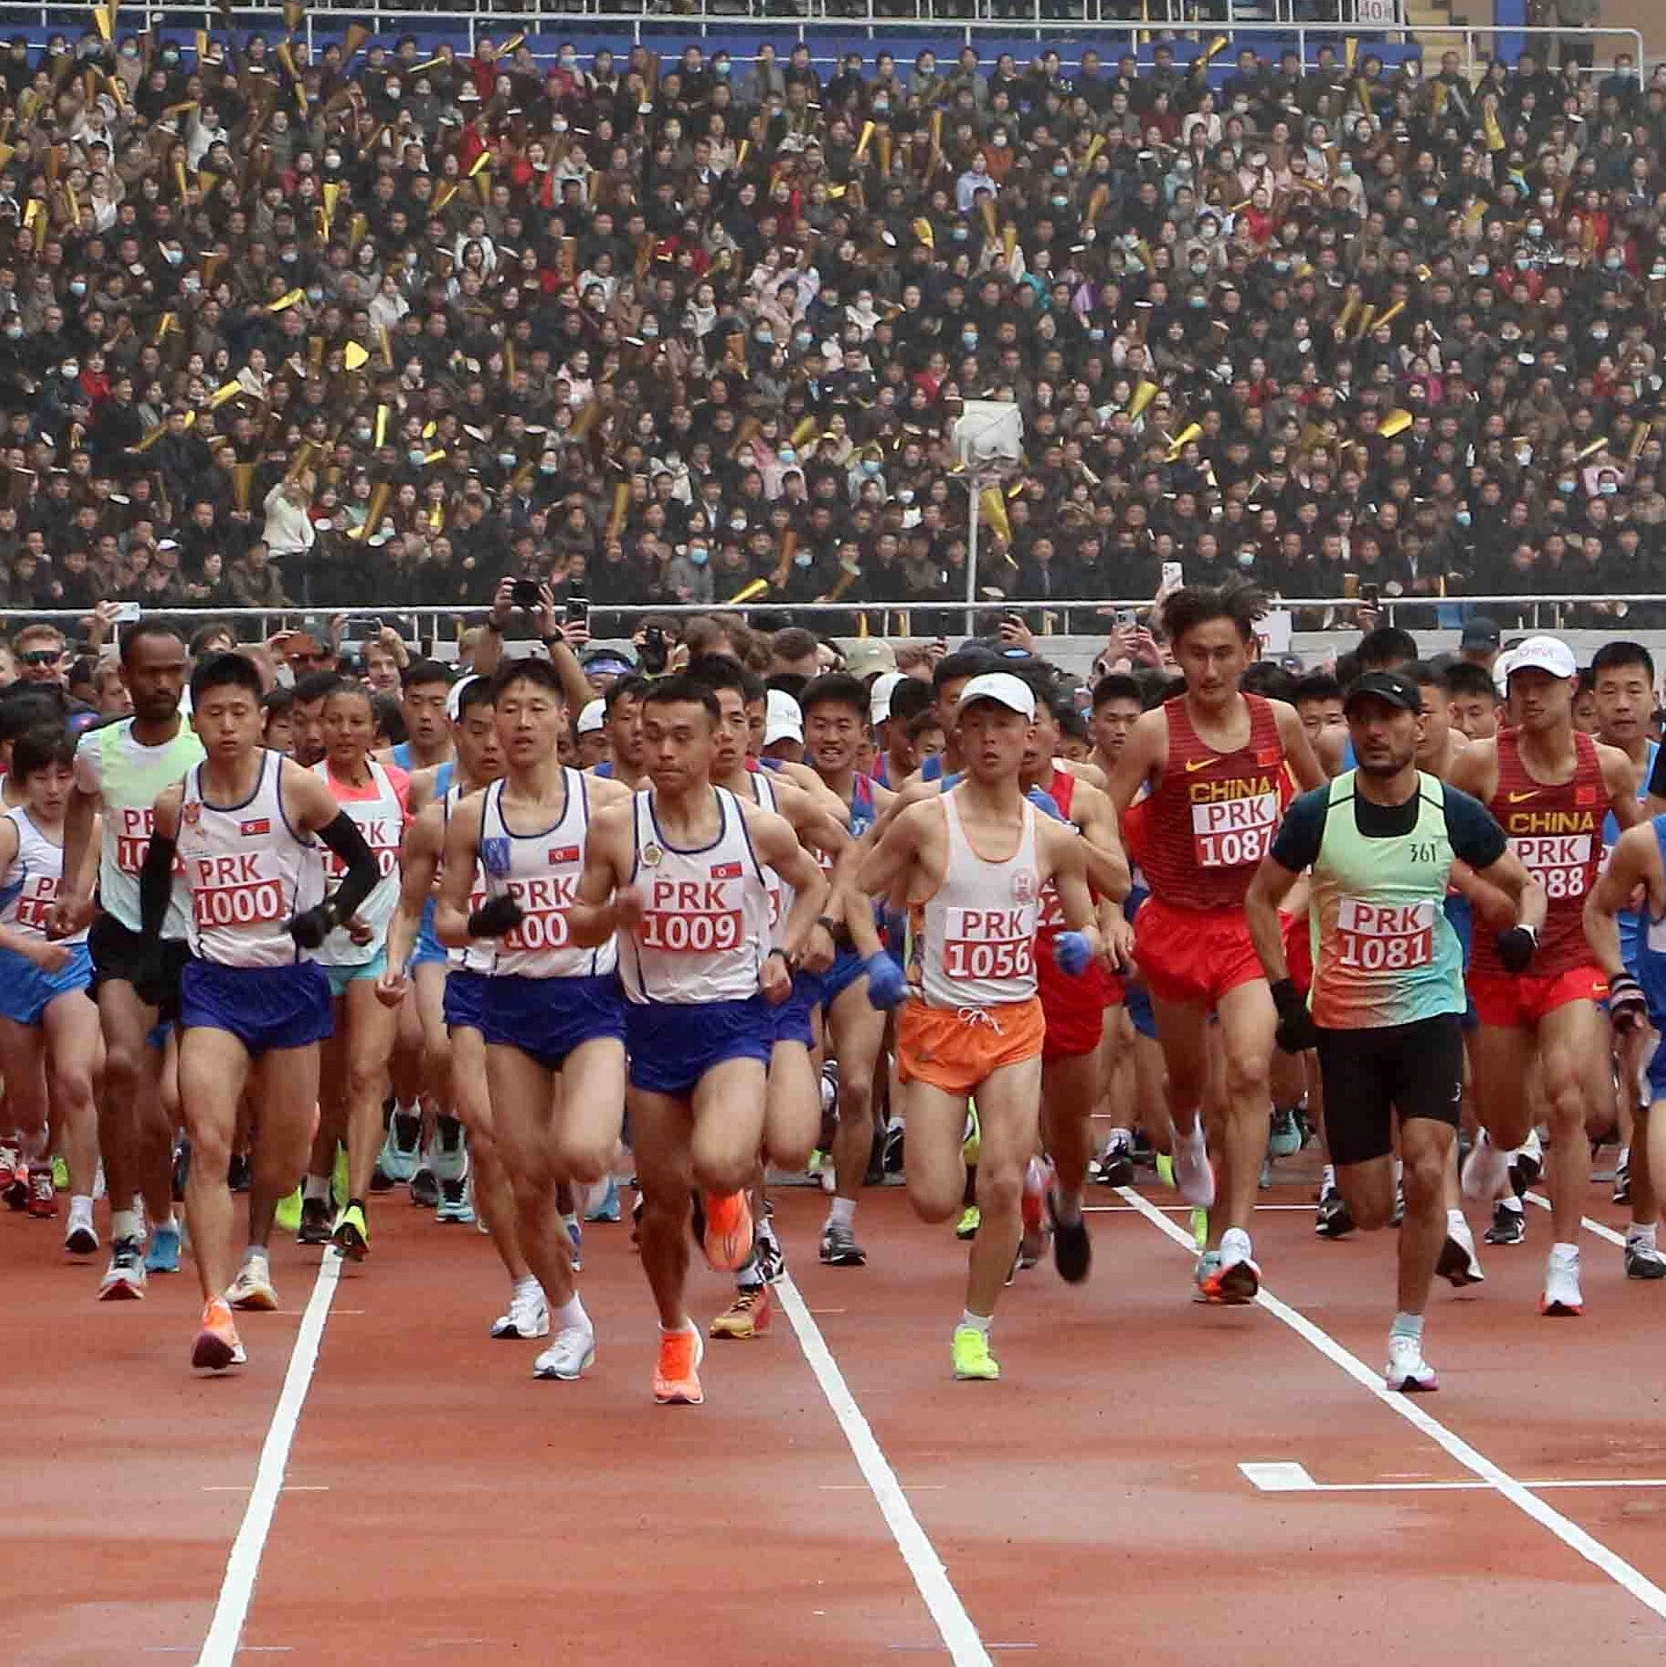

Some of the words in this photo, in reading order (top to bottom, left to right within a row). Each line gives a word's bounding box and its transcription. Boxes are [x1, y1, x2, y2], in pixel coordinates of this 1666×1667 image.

[1190, 776, 1271, 803] CHINA
[1208, 796, 1268, 831] PRK
[1509, 811, 1595, 834] CHINA
[1200, 826, 1274, 867] 1087
[1410, 843, 1436, 863] 361
[1517, 838, 1578, 864] PRK
[197, 853, 263, 886] PRK
[198, 884, 278, 925] 1000
[505, 876, 576, 908] PRK
[653, 881, 728, 910] PRK
[643, 914, 736, 950] 1009
[962, 908, 1024, 939] PRK
[1354, 903, 1421, 934] PRK
[949, 941, 1030, 978] 1056
[1340, 933, 1427, 970] 1081
